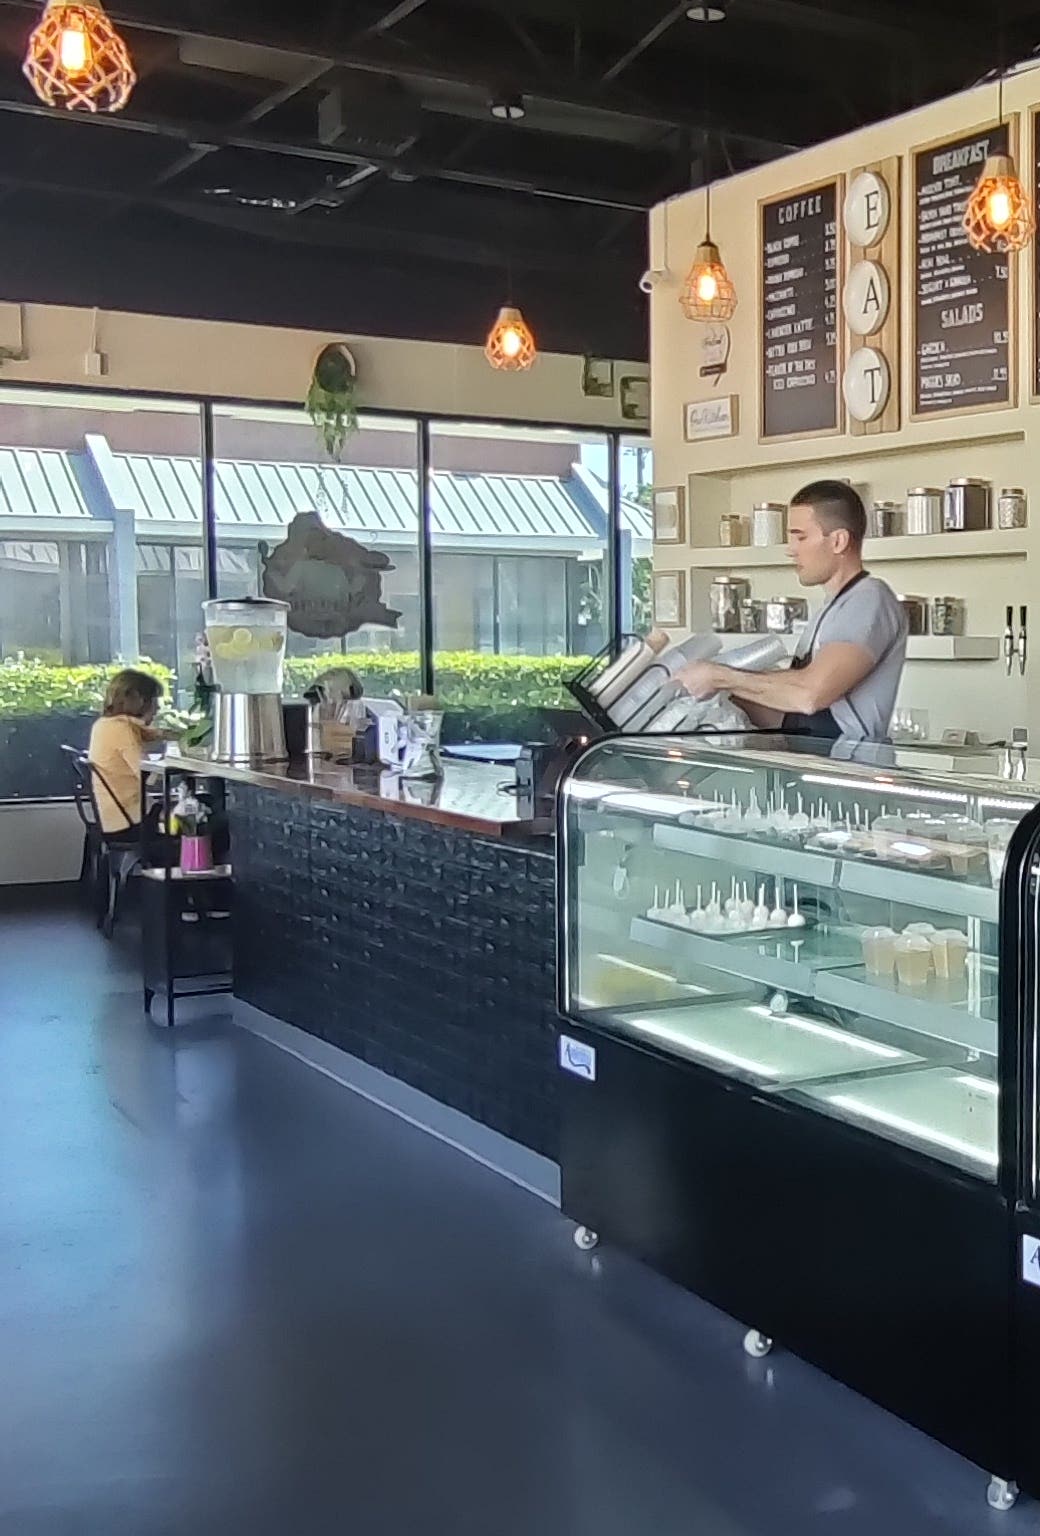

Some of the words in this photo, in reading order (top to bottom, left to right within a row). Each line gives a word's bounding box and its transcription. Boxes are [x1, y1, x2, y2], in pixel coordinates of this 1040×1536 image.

[932, 139, 990, 175] BREAKFAST
[778, 195, 822, 225] COFFEE
[941, 303, 984, 329] SALADS
